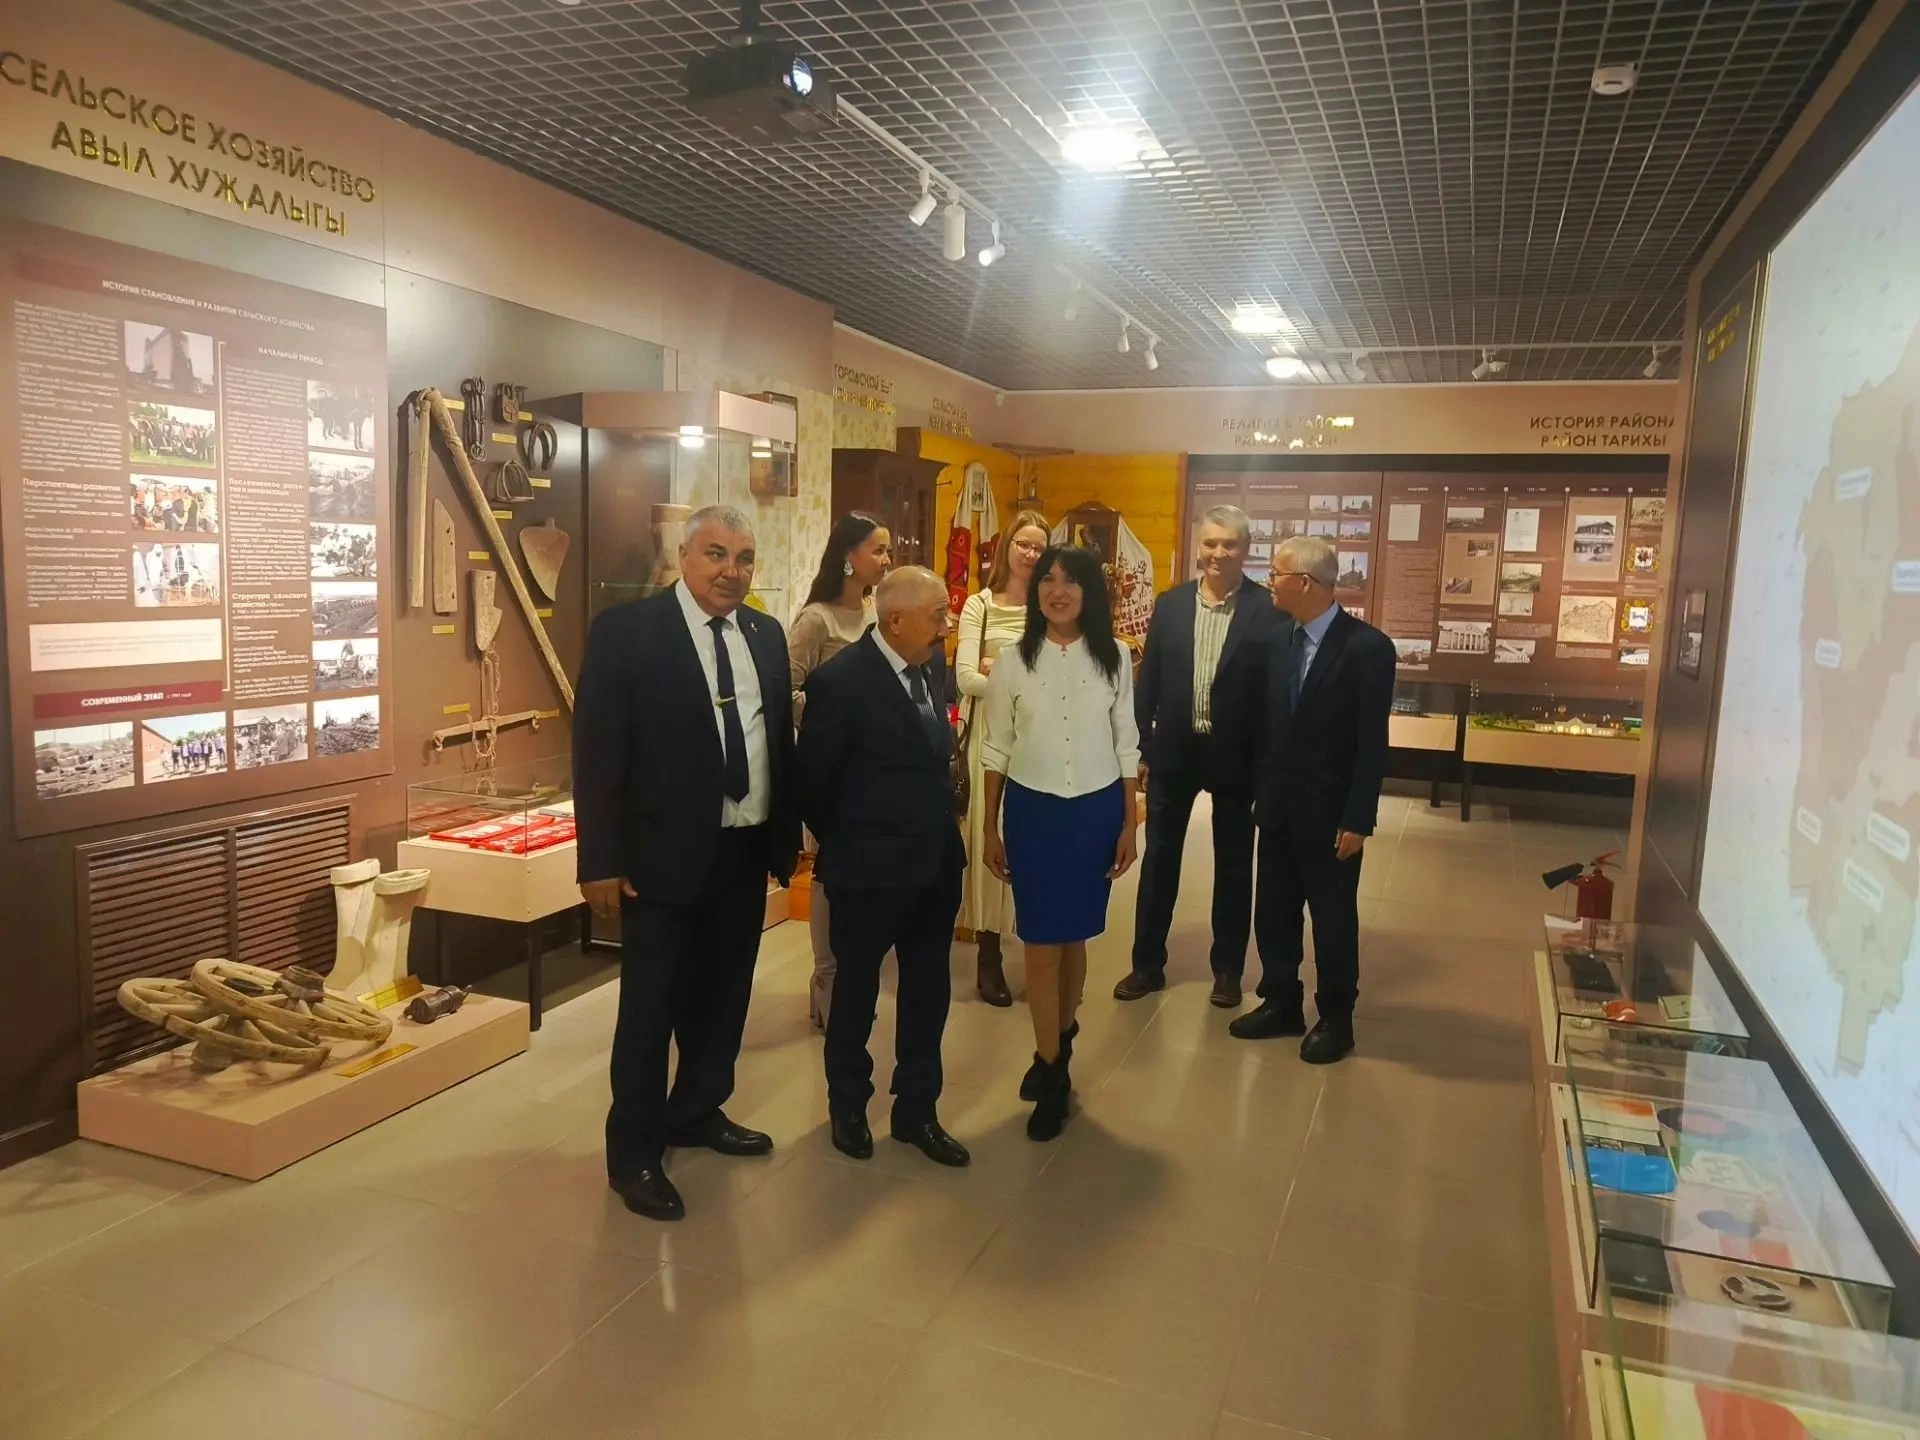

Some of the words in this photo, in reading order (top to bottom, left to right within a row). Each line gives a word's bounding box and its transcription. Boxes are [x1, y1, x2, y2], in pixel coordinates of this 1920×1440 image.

[0, 51, 196, 144] СЕЛЬСКОЕ
[206, 121, 376, 204] ХОЗЯЙСТВО
[51, 121, 156, 179] АВЫЛ
[167, 155, 346, 237] ХУҖАЛЫГЫ
[102, 280, 140, 296] ИСТОРИЯ
[141, 287, 195, 308] СТАНОВЛЕНИЯ
[1529, 416, 1605, 429] ИСТОРИЯ
[1540, 433, 1597, 448] РАЙОН
[1602, 434, 1666, 448] ТАРИХЫ
[81, 693, 142, 707] СОВРЕМЕННЫЙ
[143, 692, 164, 701] ЭТАП
